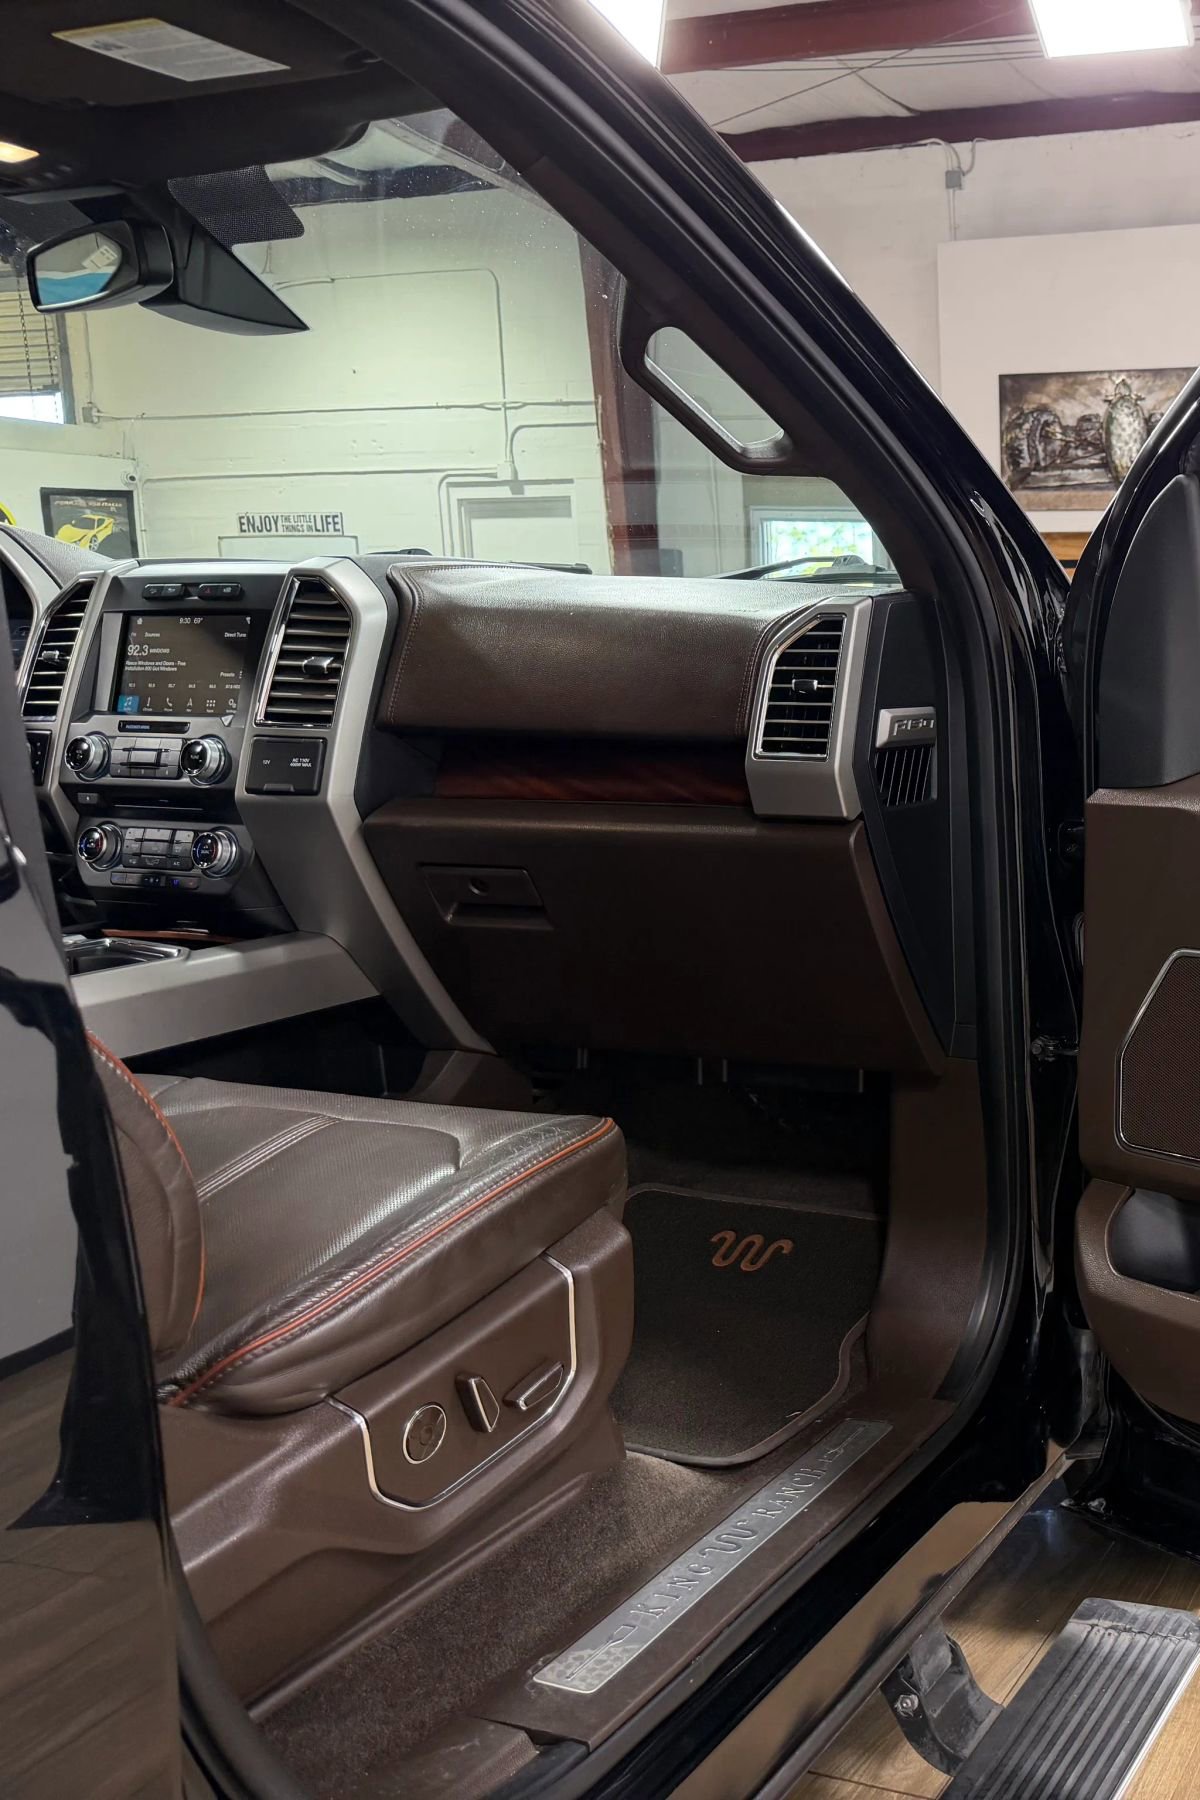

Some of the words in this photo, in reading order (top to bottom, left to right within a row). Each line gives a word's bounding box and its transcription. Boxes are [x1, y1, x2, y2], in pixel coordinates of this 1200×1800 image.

[238, 515, 279, 533] ENJOY
[280, 515, 291, 523] THE
[293, 515, 312, 523] LITTLE
[313, 515, 340, 532] LIFE
[281, 525, 305, 533] THINGS
[127, 644, 149, 656] 92.3
[630, 1563, 713, 1618] KING
[752, 1467, 827, 1519] RANCH
